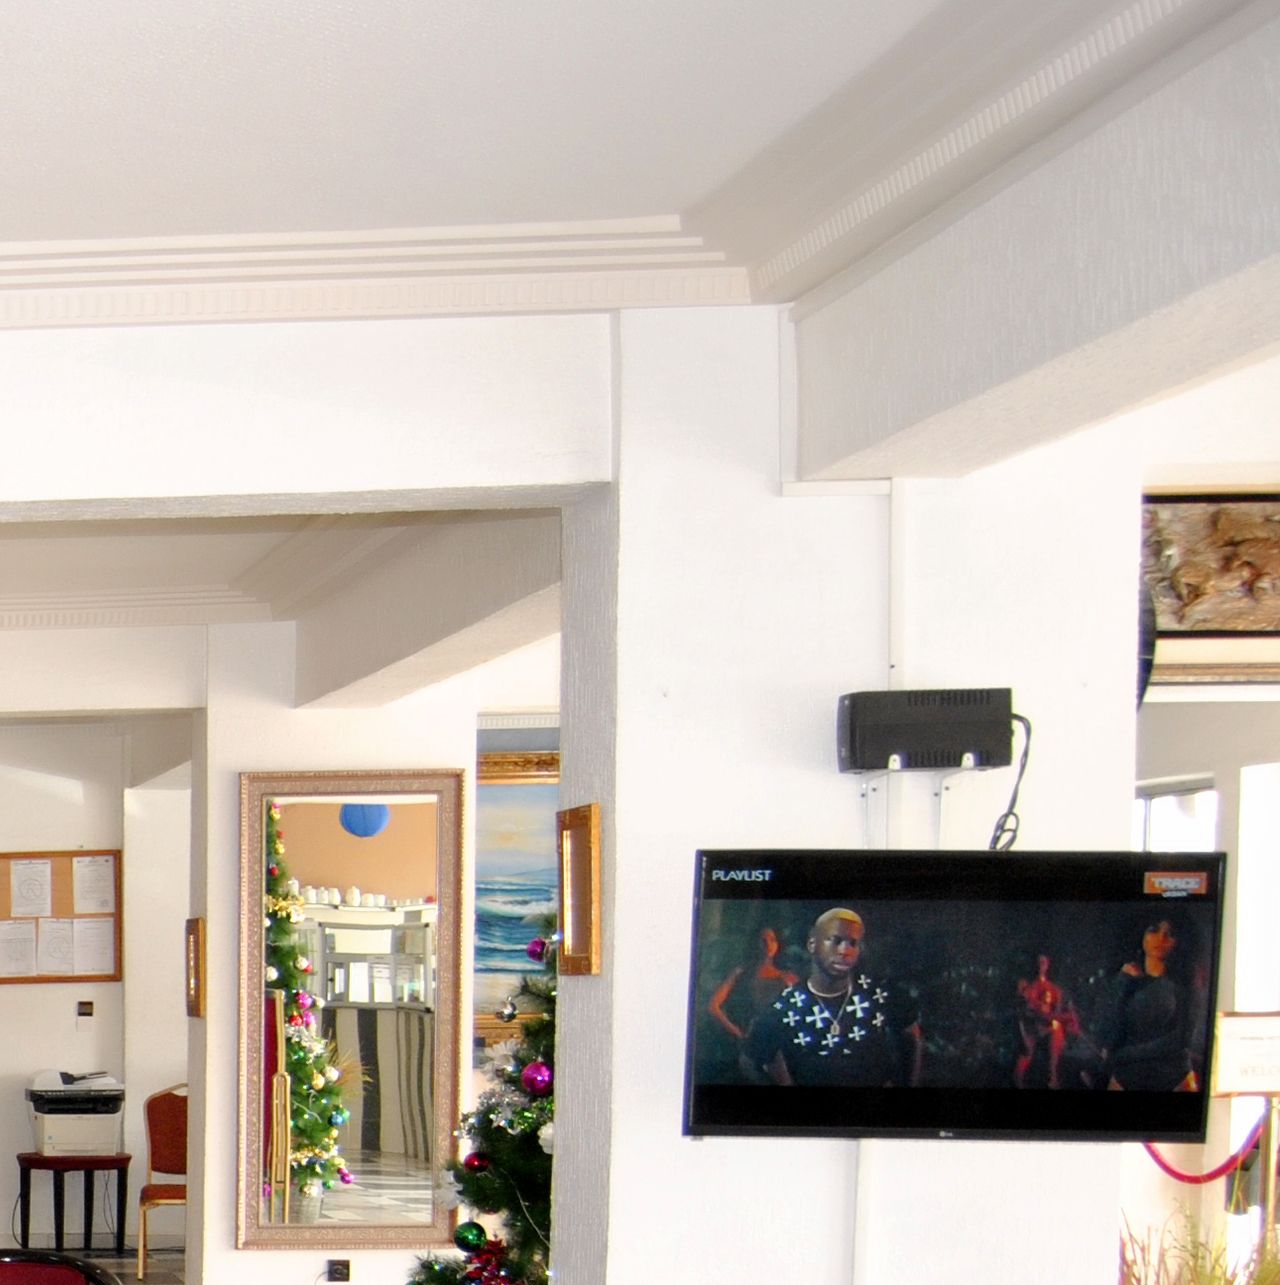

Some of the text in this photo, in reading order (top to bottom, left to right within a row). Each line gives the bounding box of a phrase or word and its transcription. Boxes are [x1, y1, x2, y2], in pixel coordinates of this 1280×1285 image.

[711, 869, 772, 882] PLAYLIST
[1151, 877, 1202, 890] TRACE
[1239, 1064, 1280, 1078] WELC
